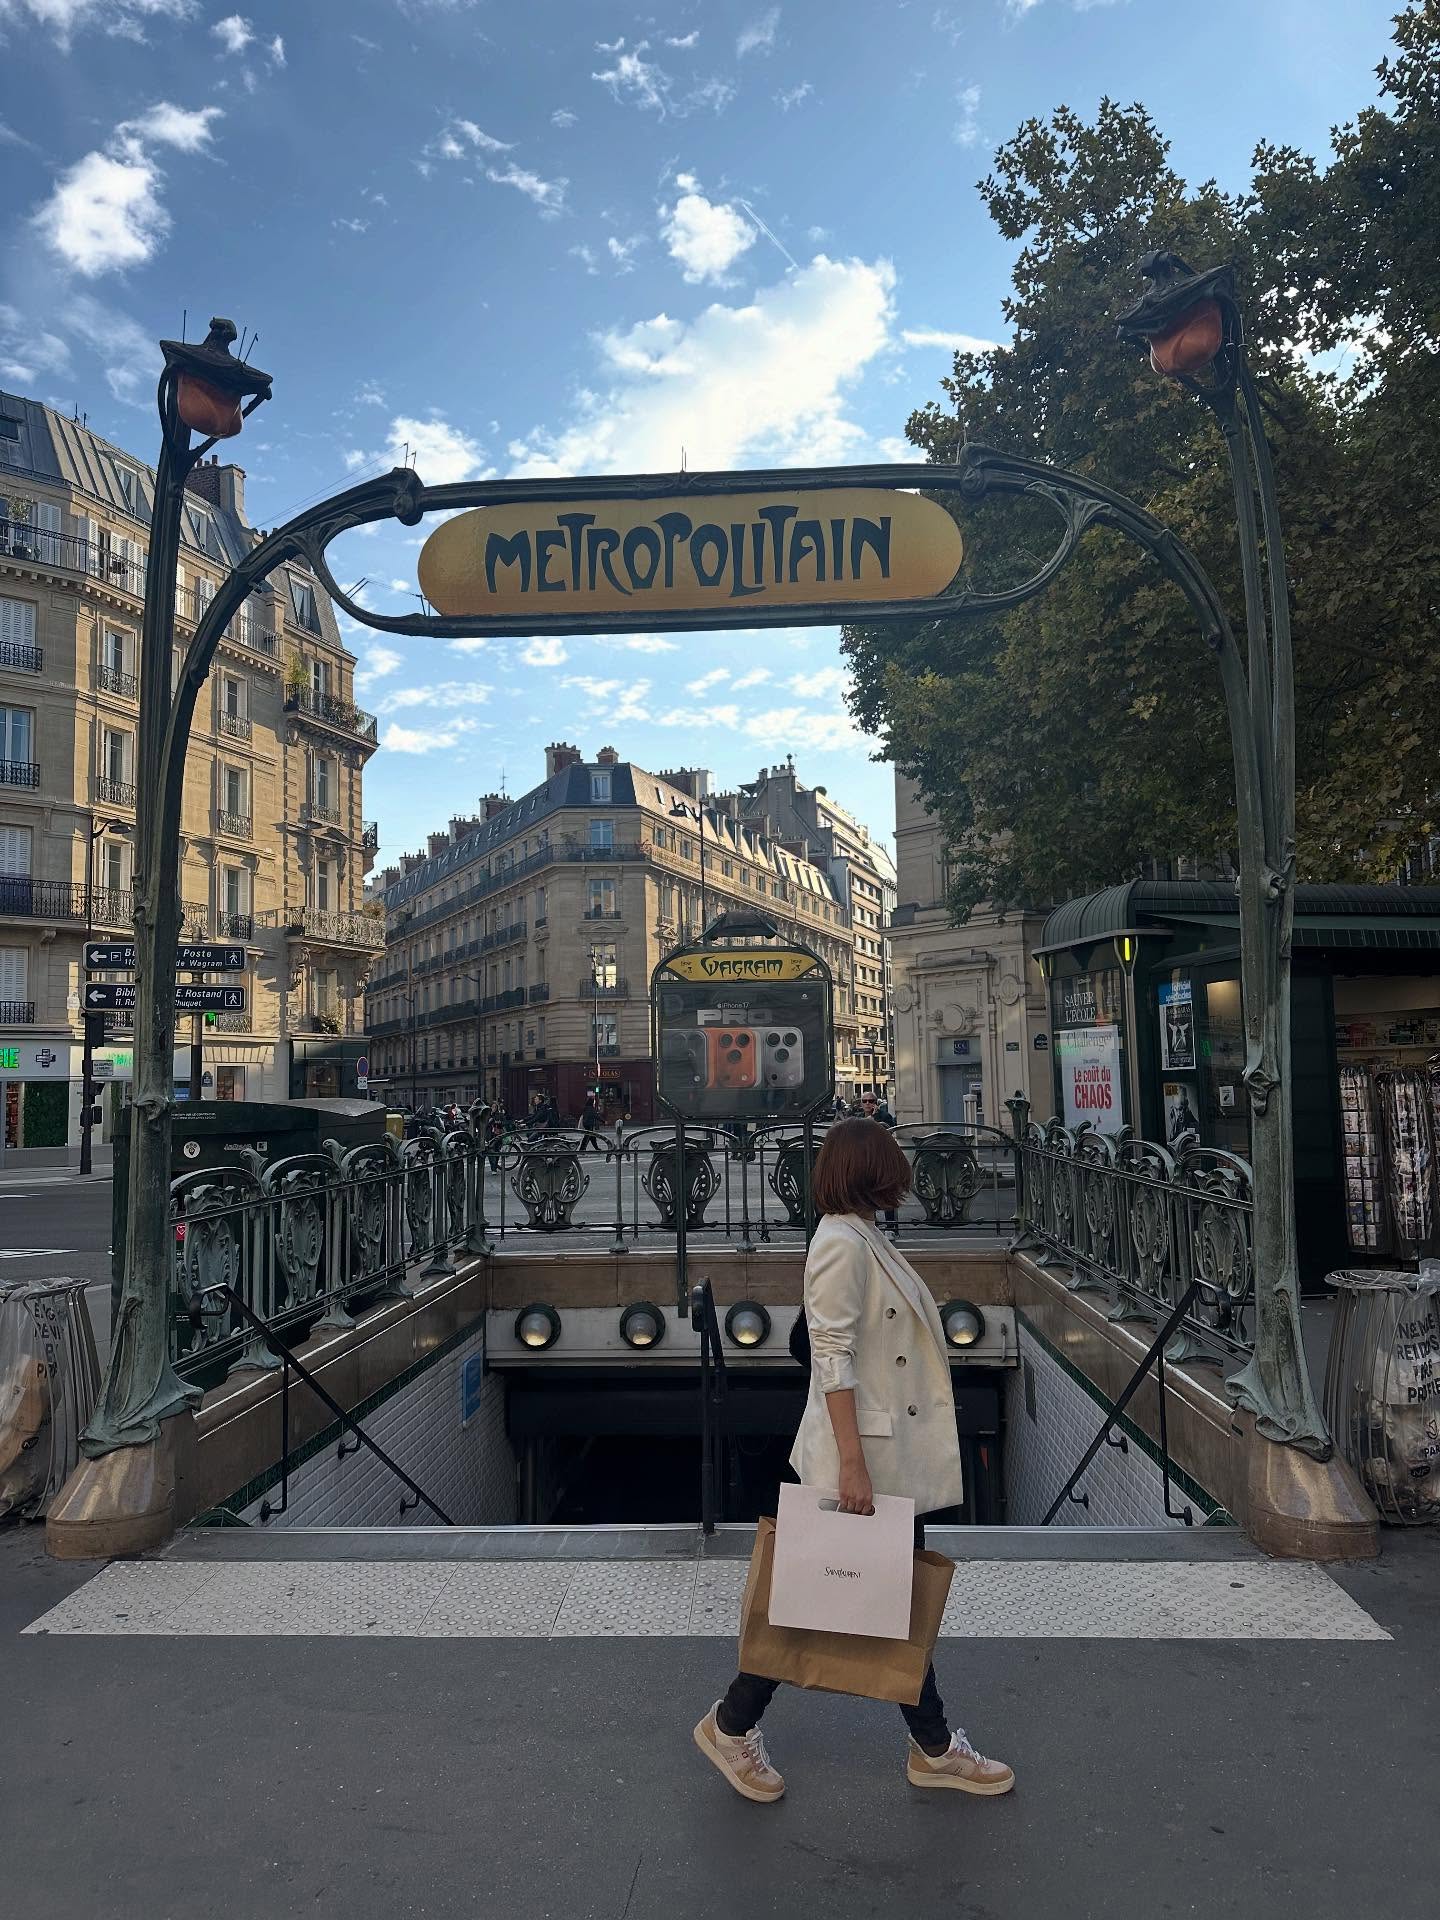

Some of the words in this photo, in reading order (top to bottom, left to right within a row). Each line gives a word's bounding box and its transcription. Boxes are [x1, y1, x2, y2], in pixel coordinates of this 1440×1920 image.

[485, 504, 892, 598] METROPOLITAIN
[183, 949, 212, 957] Poste
[189, 960, 223, 968] Wagram
[1064, 991, 1094, 1008] SAUVER
[697, 1009, 773, 1026] PRO
[1074, 1067, 1081, 1083] Le
[1084, 1066, 1099, 1082] coût
[1101, 1066, 1111, 1082] du
[1074, 1083, 1112, 1109] CHAOS
